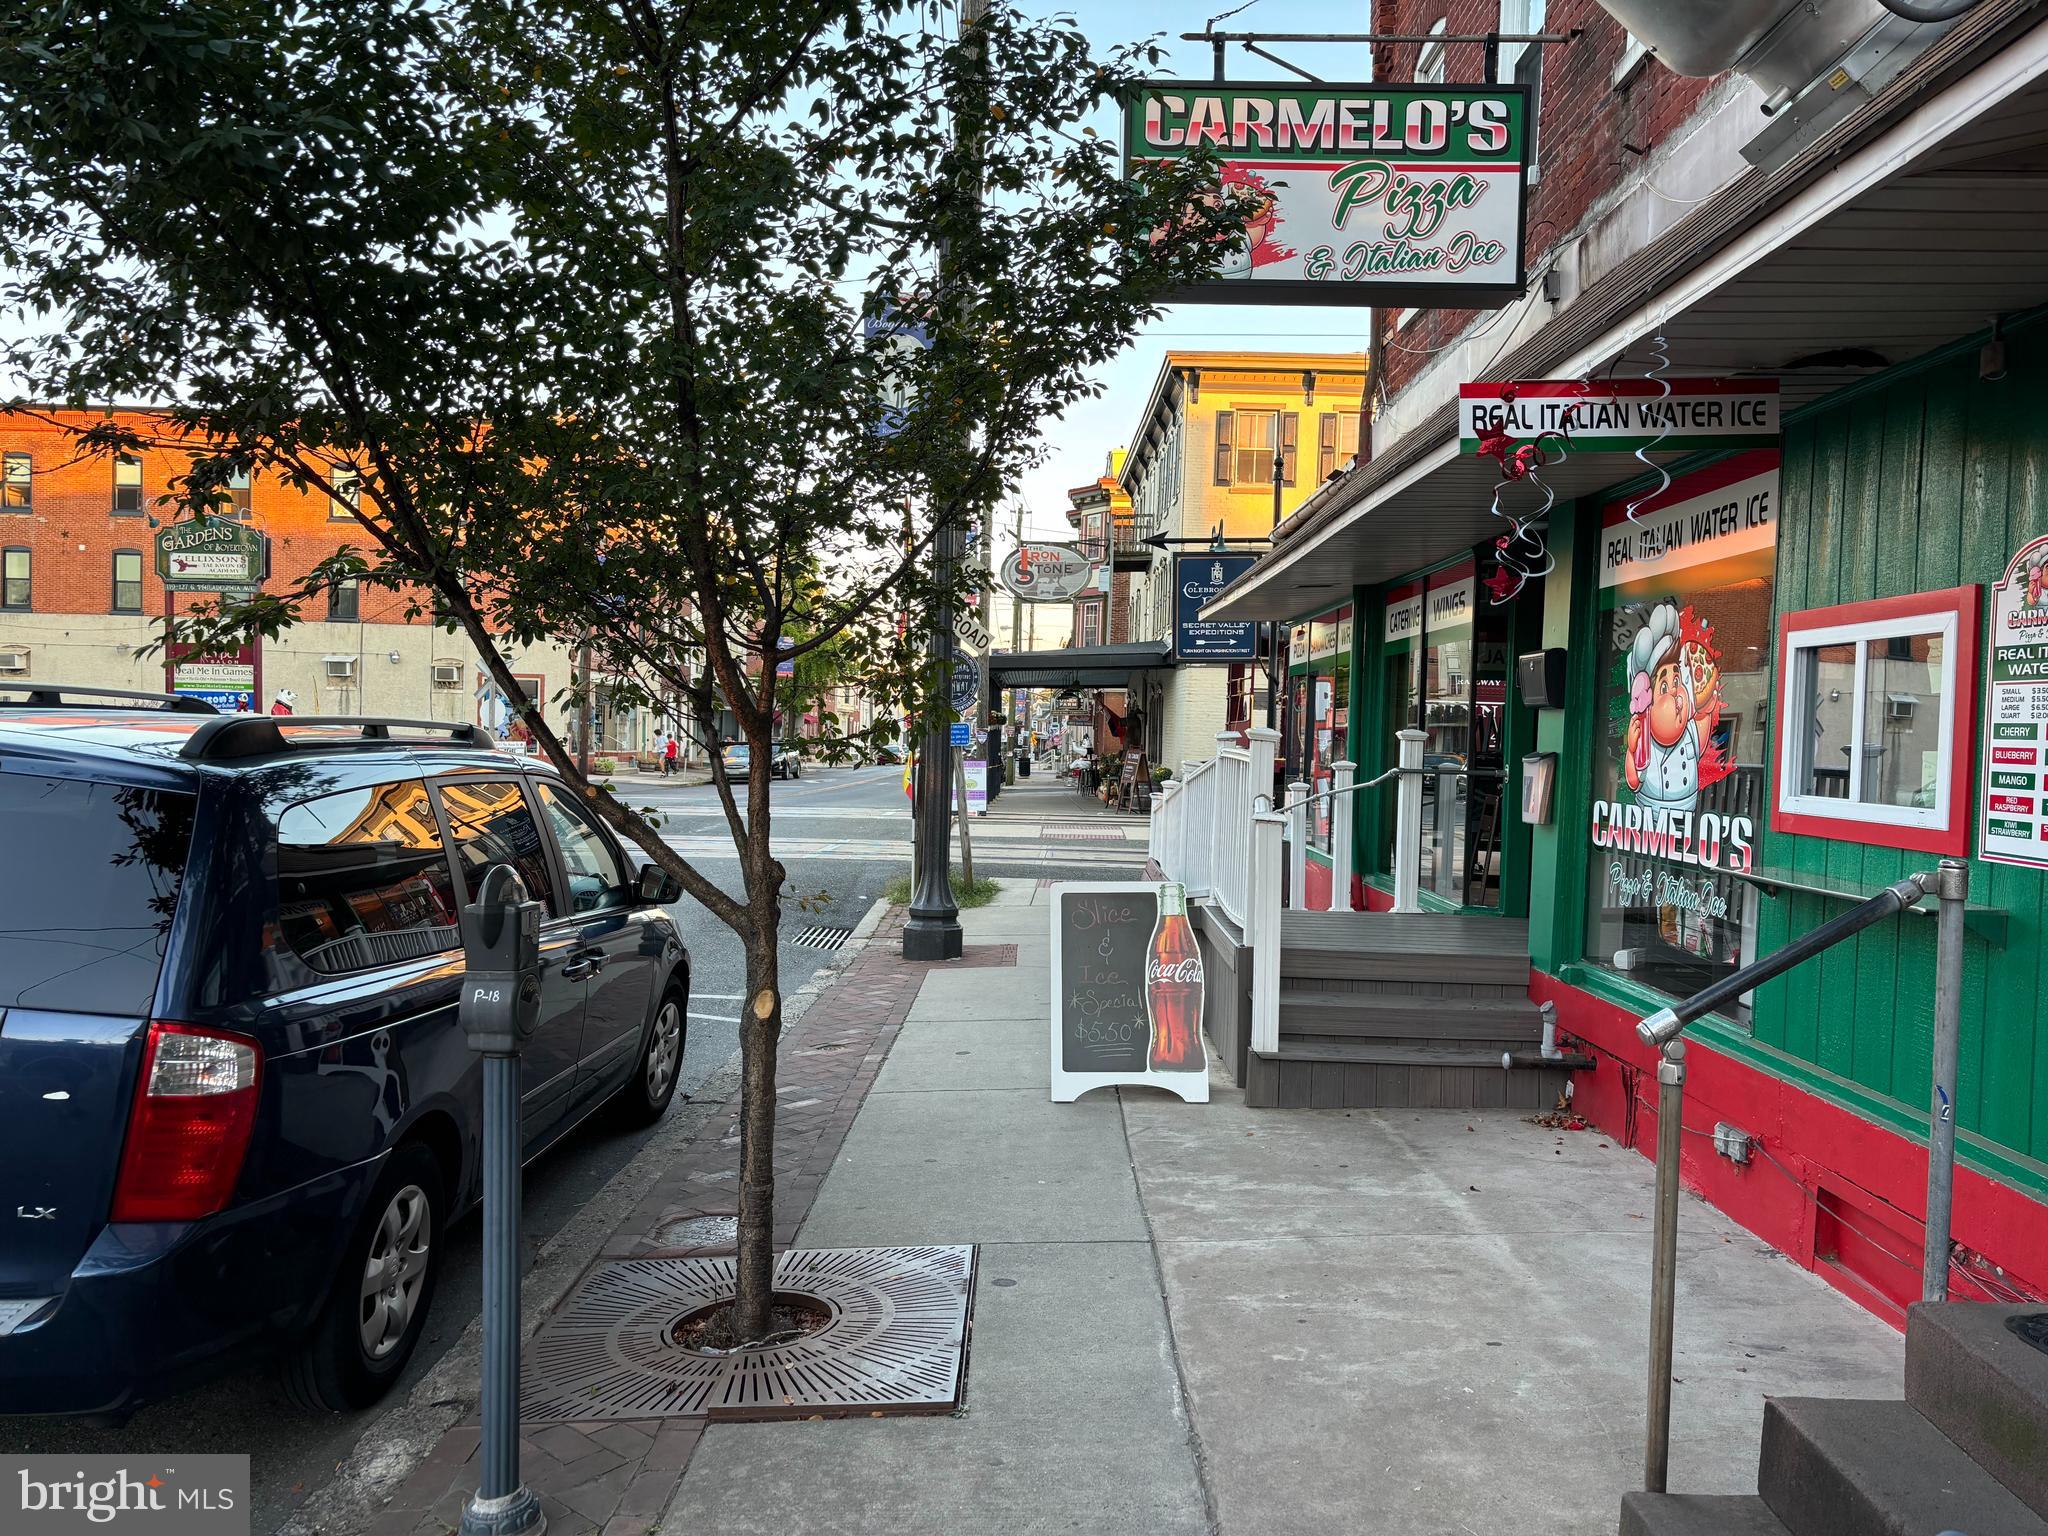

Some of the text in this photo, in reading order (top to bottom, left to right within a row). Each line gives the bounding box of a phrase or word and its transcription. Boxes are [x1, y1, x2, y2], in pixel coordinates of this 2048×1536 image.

[1144, 94, 1509, 152] CARMELO'S
[1328, 160, 1488, 240] Pizza
[1304, 231, 1504, 281] & Italian Ice
[1472, 400, 1767, 430] REAL ITALIAN WATER ICE
[179, 526, 192, 534] THE
[1607, 491, 1769, 569] REAL ITALIAN WATER ICE
[162, 527, 233, 551] GARDENS
[203, 543, 214, 551] OF
[1433, 590, 1466, 622] WINGS
[1389, 604, 1421, 634] CATERING
[2007, 606, 2048, 629] CARM
[2019, 629, 2037, 643] Pizza
[2037, 628, 2045, 638] &
[1998, 648, 2035, 661] REAL
[196, 667, 210, 675] Me
[211, 667, 220, 675] In
[222, 667, 253, 676] Games
[2008, 662, 2048, 676] WATE
[2000, 726, 2030, 737] CHERRY
[1995, 750, 2034, 760] BLUEBERRY
[1998, 774, 2028, 786] MANGO
[2005, 796, 2018, 804] RED
[1994, 803, 2029, 813] RASPBERRY
[1991, 827, 2031, 838] STRAWBERRY
[2004, 821, 2018, 829] KIWI
[1592, 800, 1753, 875] CARMELO'S
[1609, 861, 1727, 919] Pizza & Italian Ice
[1071, 899, 1138, 930] Slice
[1098, 929, 1113, 965] &
[1079, 965, 1128, 985] Ice
[473, 989, 500, 1003] P-18
[17, 1205, 57, 1220] LX
